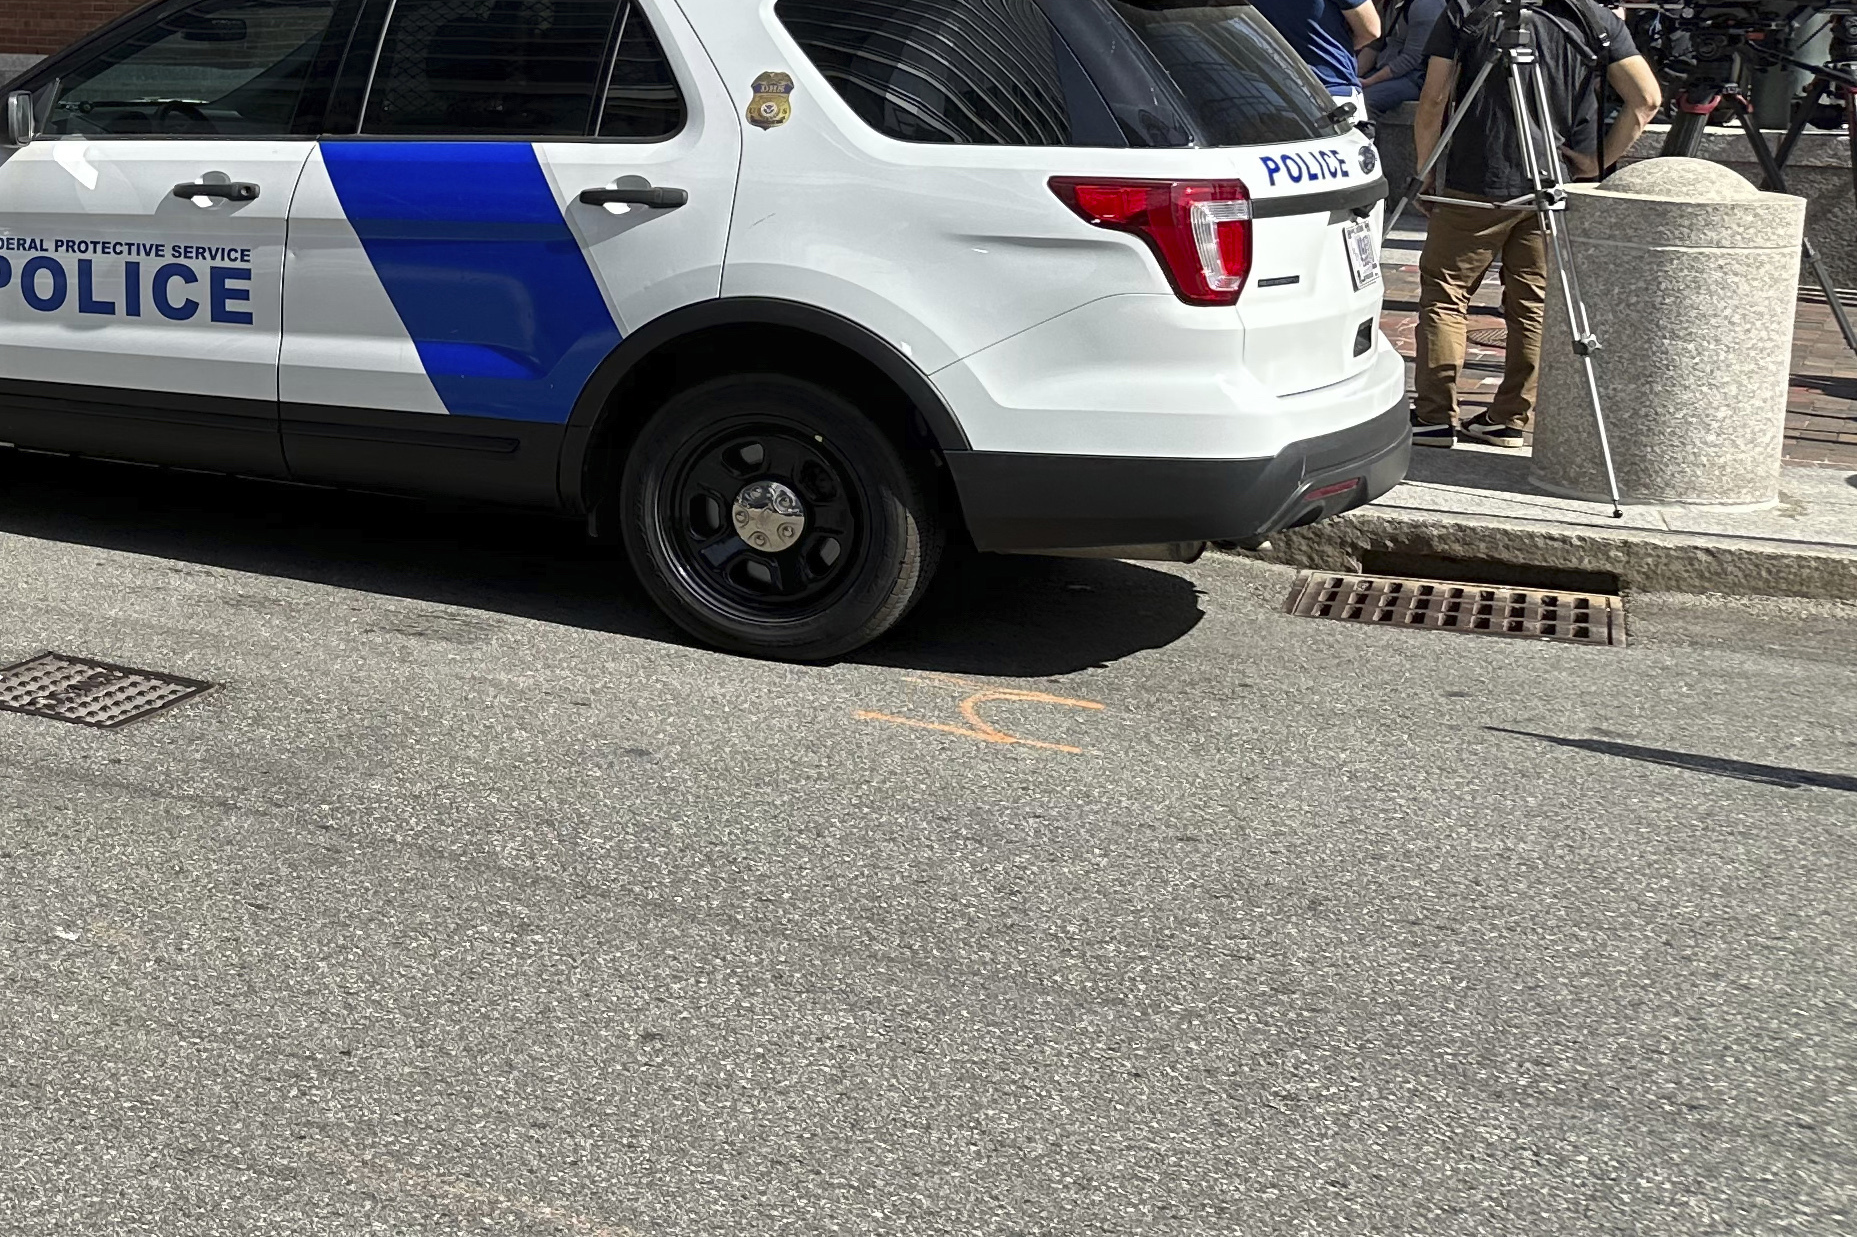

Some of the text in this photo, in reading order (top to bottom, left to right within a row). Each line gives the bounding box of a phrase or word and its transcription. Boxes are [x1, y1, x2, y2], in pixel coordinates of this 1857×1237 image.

[1258, 149, 1350, 187] POLICE
[54, 238, 166, 258] PROTECTIVE
[170, 244, 252, 263] SERVICE
